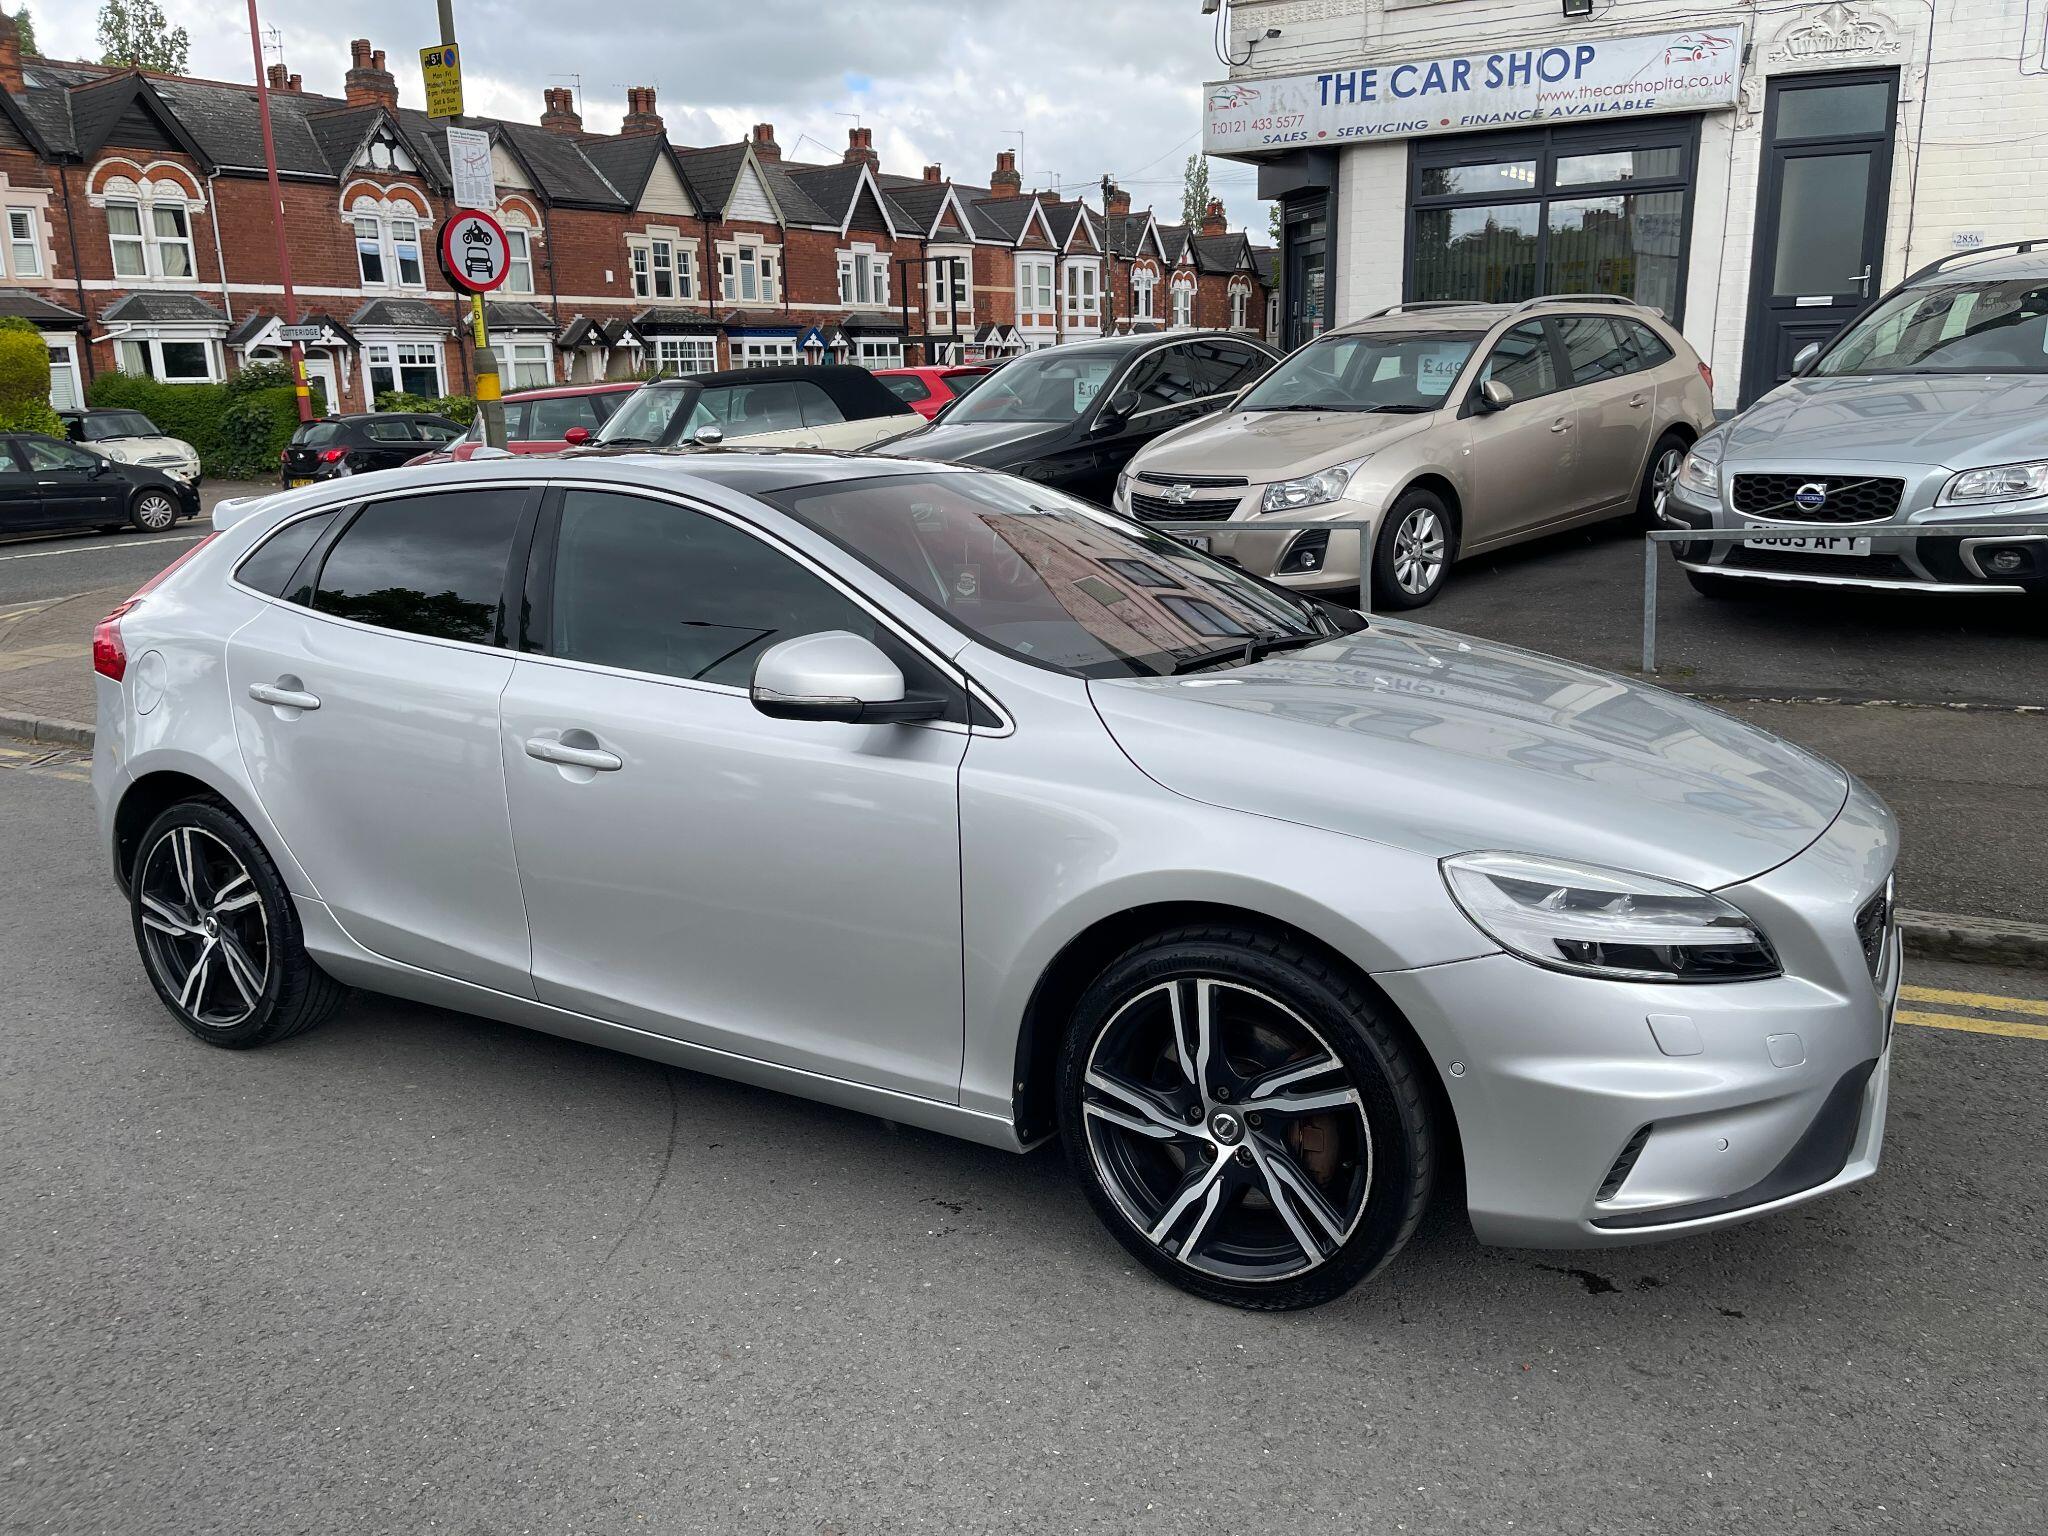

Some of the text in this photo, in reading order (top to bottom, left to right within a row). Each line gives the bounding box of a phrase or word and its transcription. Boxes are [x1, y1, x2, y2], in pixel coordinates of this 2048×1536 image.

[1317, 45, 1595, 106] THE CAR SHOP
[1535, 72, 1732, 102] www.thecarshopltd.co.uk
[1212, 114, 1305, 135] T:0121 433 5577
[1262, 98, 1656, 144] SALES SERVICING FINANCE AVAILABLE
[1956, 234, 1979, 244] 285A
[281, 328, 319, 337] COTTERIDGE
